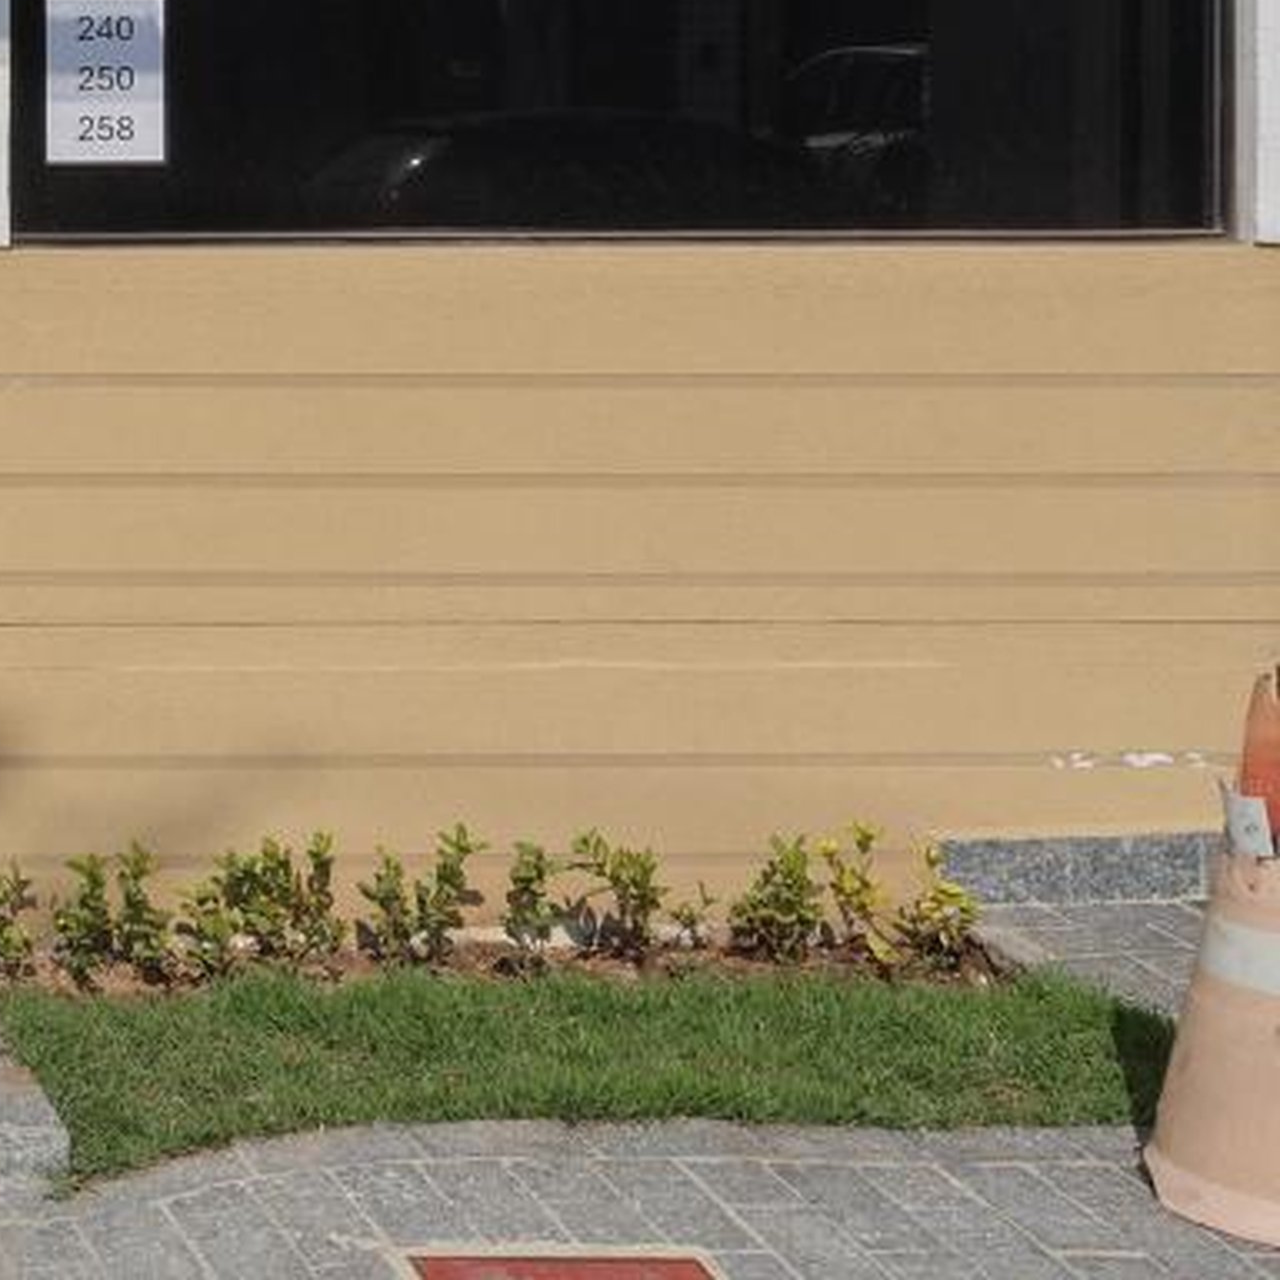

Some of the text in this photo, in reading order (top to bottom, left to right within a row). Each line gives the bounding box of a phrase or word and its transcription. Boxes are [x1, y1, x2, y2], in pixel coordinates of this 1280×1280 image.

[77, 16, 135, 41] 240
[78, 66, 135, 91] 250
[78, 116, 135, 141] 258
